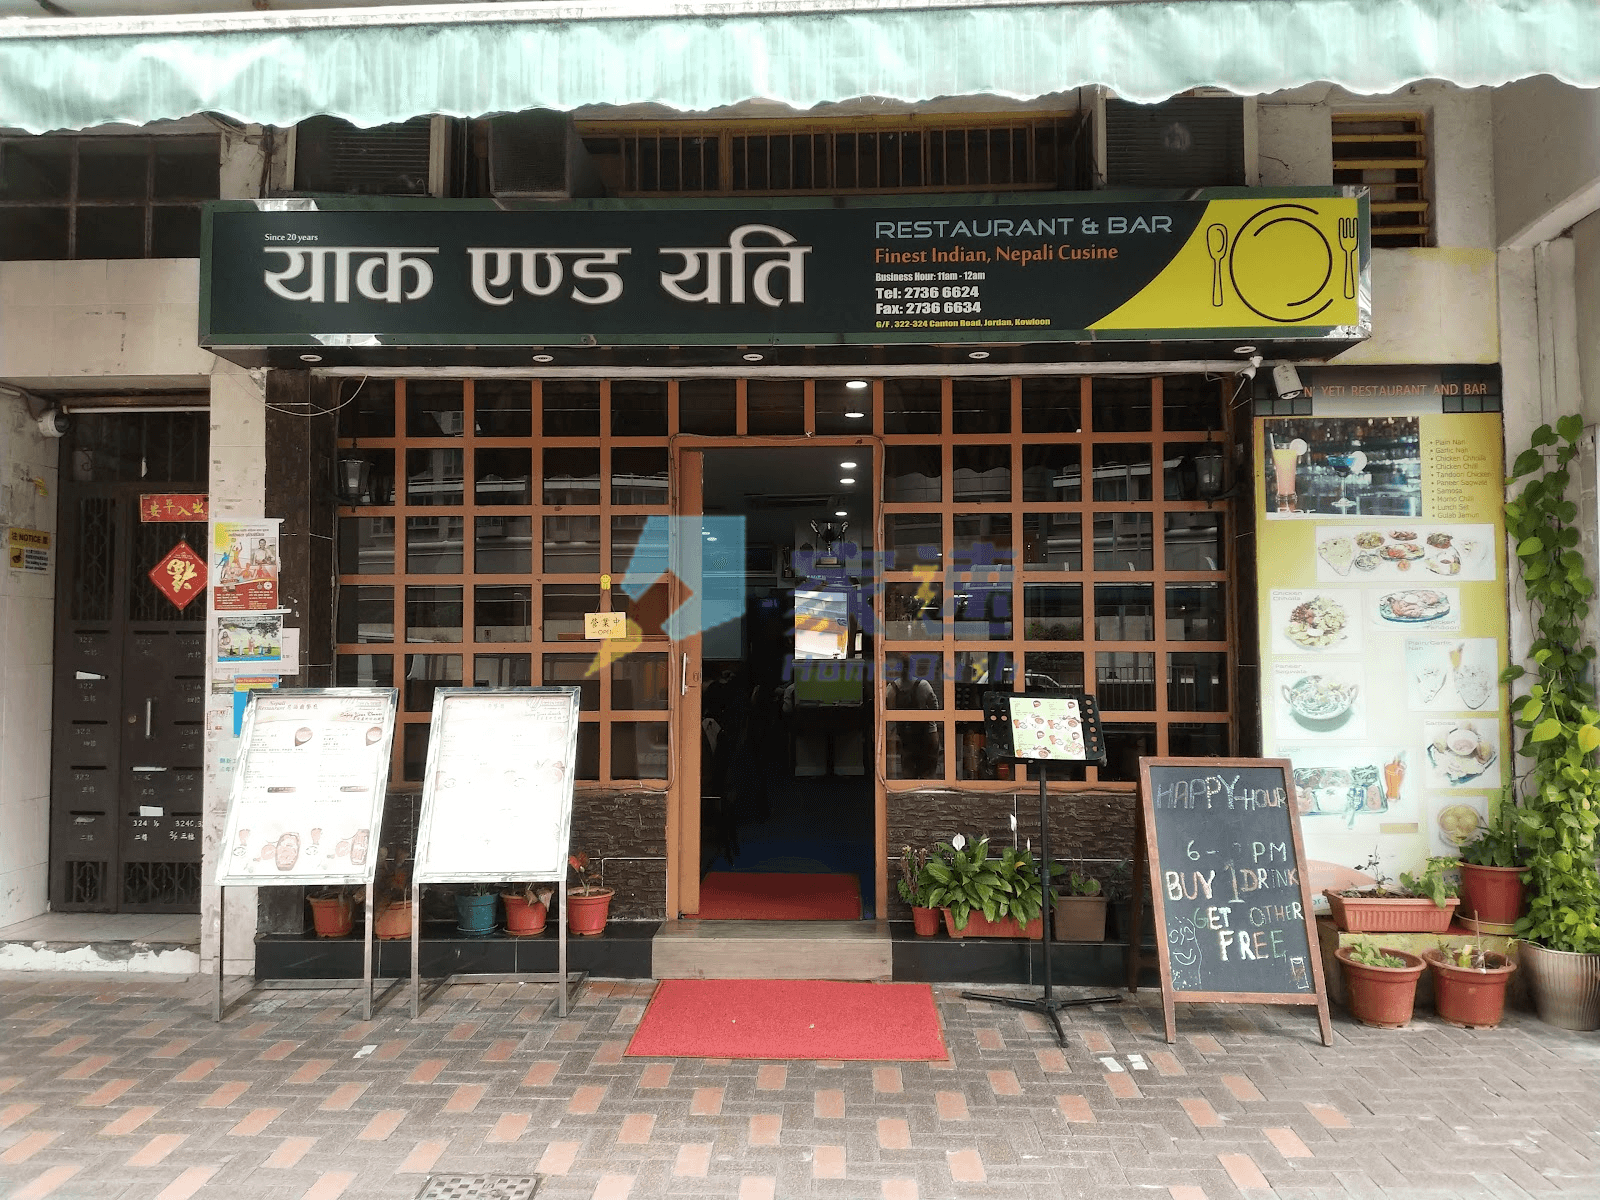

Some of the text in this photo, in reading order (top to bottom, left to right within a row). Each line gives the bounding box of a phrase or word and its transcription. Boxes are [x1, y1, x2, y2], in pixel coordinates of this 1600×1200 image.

[875, 215, 1173, 239] RESTAURANT & BAR
[264, 233, 319, 243] Since 20 years
[875, 244, 1119, 266] Finest Indian, Nepali Cusine
[263, 224, 813, 308] याक एण्ड यति
[875, 273, 913, 282] Business
[914, 272, 936, 282] Hour:
[937, 272, 958, 281] 11am
[963, 271, 986, 280] 12am
[875, 286, 979, 299] Tel: 2736 6624
[875, 302, 982, 315] Fax: 2736 6634
[894, 320, 928, 328] 322-324
[929, 320, 958, 328] Canton
[959, 319, 983, 328] Road,
[983, 319, 1014, 327] Jordan,
[1014, 318, 1051, 326] Kowloon
[1321, 385, 1345, 397] YETI
[1351, 384, 1427, 397] RESTAURANT
[1433, 383, 1459, 396] AND
[1463, 382, 1488, 395] BAR
[18, 533, 42, 543] NOTICE
[166, 558, 198, 594] 福
[590, 617, 620, 629] 營業中
[1156, 774, 1287, 811] HAPPY HOUR
[132, 819, 148, 827] 324
[1252, 841, 1287, 864] PM
[1165, 859, 1300, 904] BUY 1 DRINK
[1193, 901, 1305, 930] GET OTHER
[1218, 929, 1287, 964] FREE
